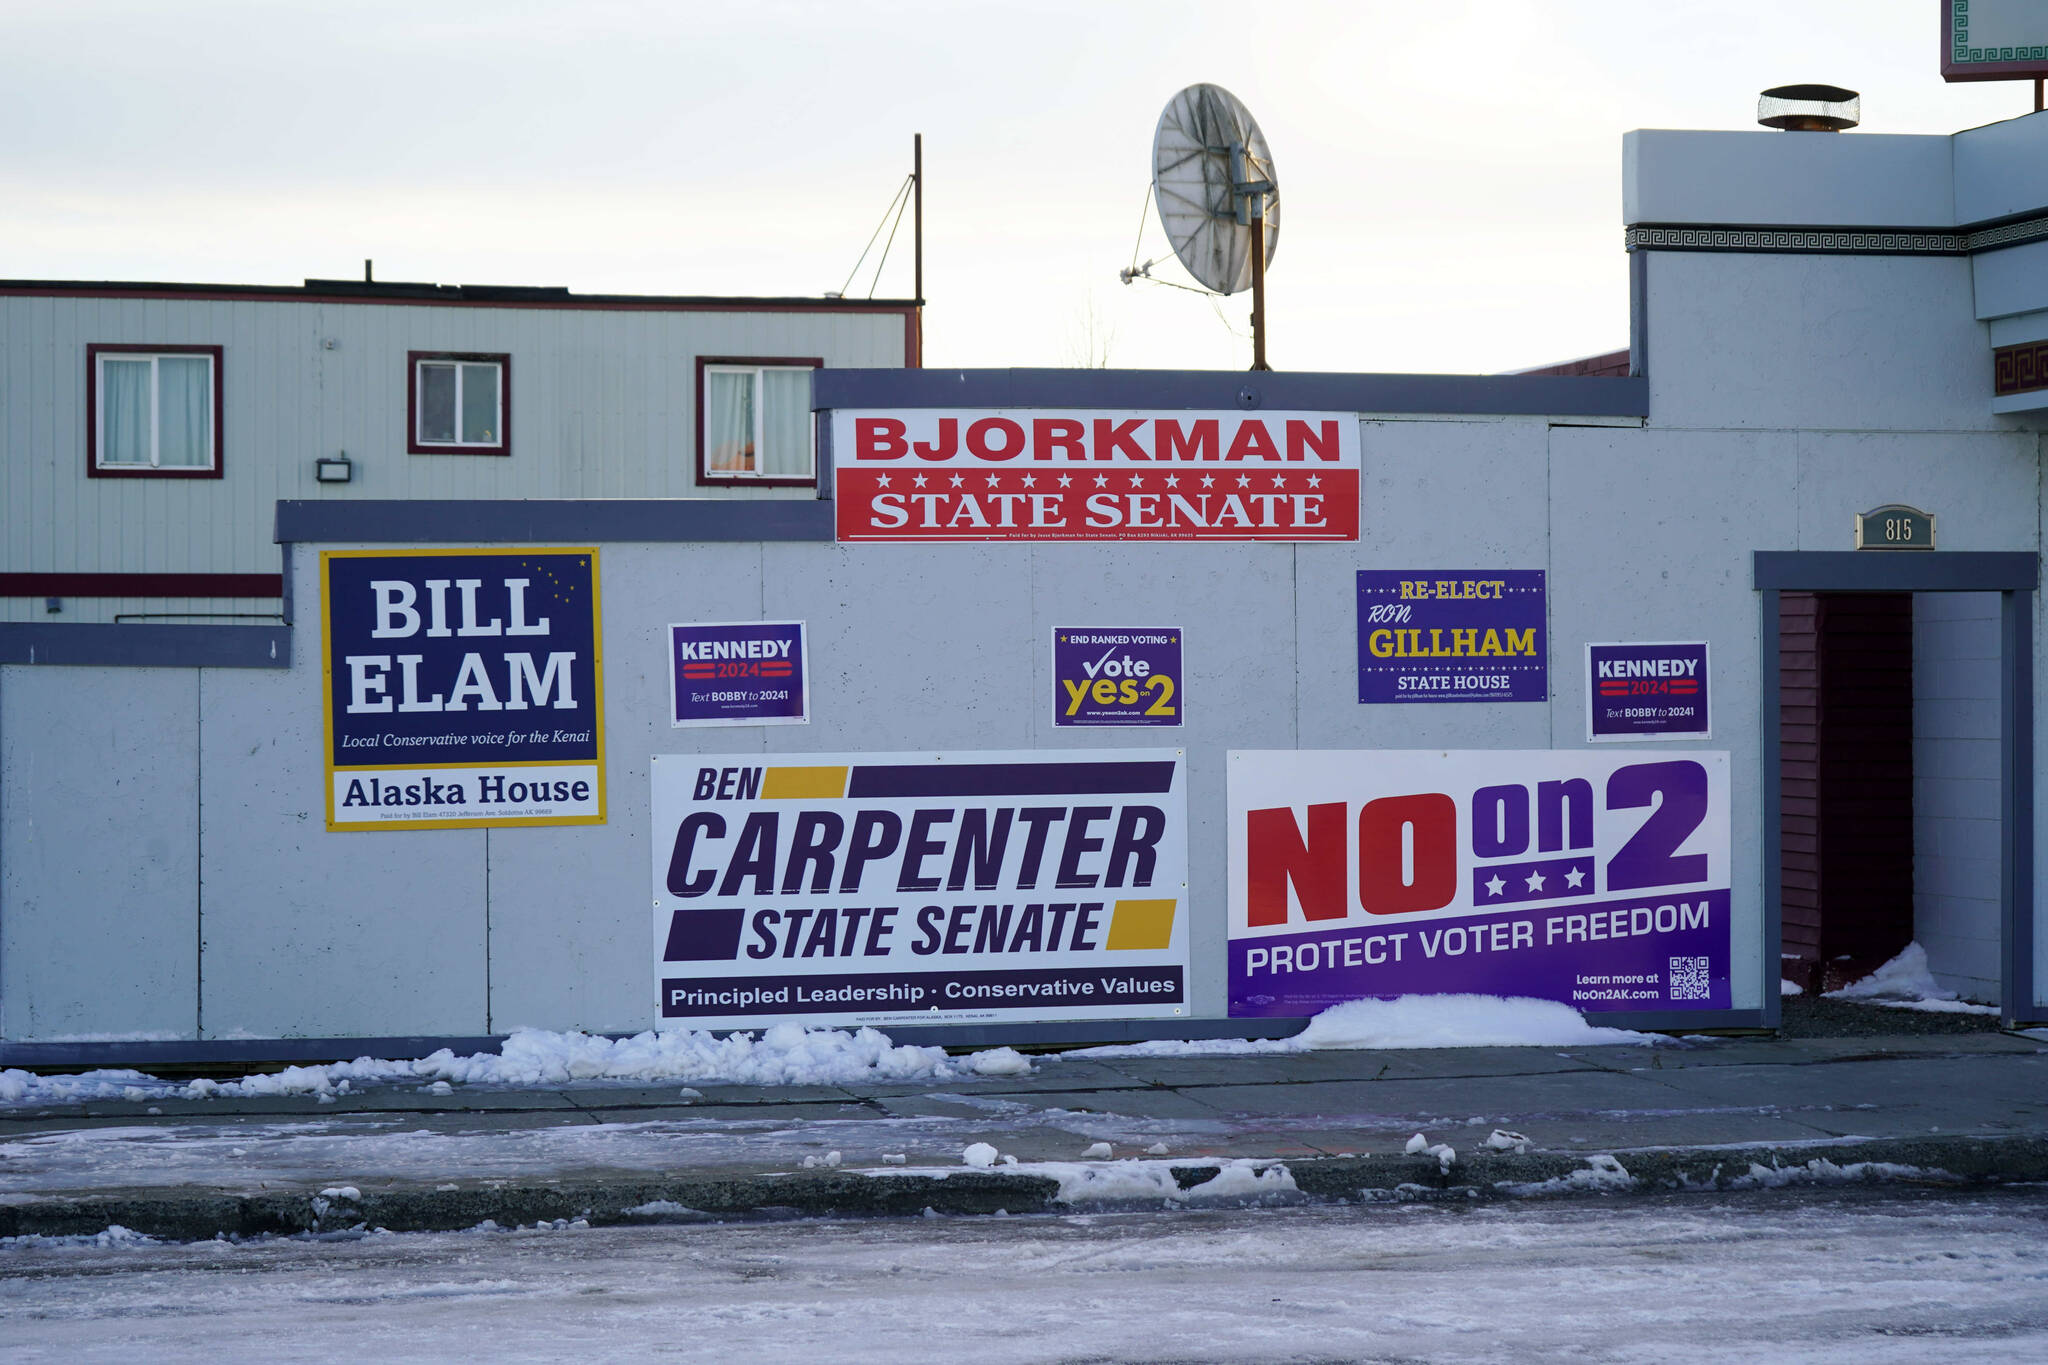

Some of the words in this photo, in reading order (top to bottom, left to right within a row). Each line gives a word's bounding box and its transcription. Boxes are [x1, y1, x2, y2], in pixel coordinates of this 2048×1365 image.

[855, 417, 1340, 462] BJORKMAN
[870, 493, 1067, 528] STATE
[1085, 493, 1328, 528] SENATE
[1886, 518, 1912, 540] 815
[1400, 581, 1505, 599] RE-ELECT
[370, 578, 550, 638] BILL
[1367, 604, 1413, 623] RON
[682, 640, 792, 660] KENNEDY
[1070, 635, 1089, 644] END
[1091, 635, 1130, 644] RANKED
[1131, 635, 1168, 644] VOTING
[1369, 628, 1537, 658] GILLHAM
[717, 662, 759, 678] 2024
[1598, 659, 1698, 678] KENNEDY
[345, 651, 578, 714] ELAM
[1398, 676, 1451, 690] STATE
[1454, 675, 1510, 690] HOUSE
[1631, 680, 1668, 695] 2024
[690, 692, 709, 702] Text
[711, 691, 747, 701] BOBBY
[749, 692, 758, 701] to
[760, 690, 788, 700] 20241
[1062, 679, 1139, 716] yes
[1144, 674, 1176, 716] 2
[1606, 708, 1623, 718] Text
[1625, 708, 1657, 717] BOBBY
[1658, 708, 1667, 717] to
[1668, 707, 1694, 717] 20241
[342, 734, 380, 748] Local
[383, 732, 468, 747] Conservative
[471, 732, 504, 745] voice
[505, 731, 527, 747] for
[529, 730, 549, 743] the
[552, 730, 591, 743] Kenai
[342, 777, 466, 807] Alaska
[478, 775, 590, 803] House
[692, 767, 762, 801] BEN
[666, 805, 1166, 898] CARPENTER
[1247, 793, 1457, 928] NO
[1472, 777, 1594, 859] on
[1606, 760, 1709, 892] 2
[746, 906, 899, 959] STATE
[911, 902, 1104, 955] SENATE
[1247, 932, 1408, 977] PROTECT
[1420, 920, 1533, 958] VOTER
[1546, 901, 1710, 946] FREEDOM
[1576, 974, 1610, 985] Learn
[1612, 976, 1643, 984] more
[1646, 974, 1659, 984] at
[671, 986, 789, 1008] Principled
[797, 984, 925, 1003] Leadership
[945, 978, 1095, 998] Conservative
[1101, 976, 1176, 996] Values
[1573, 989, 1659, 1000] NoOn2AK.com
